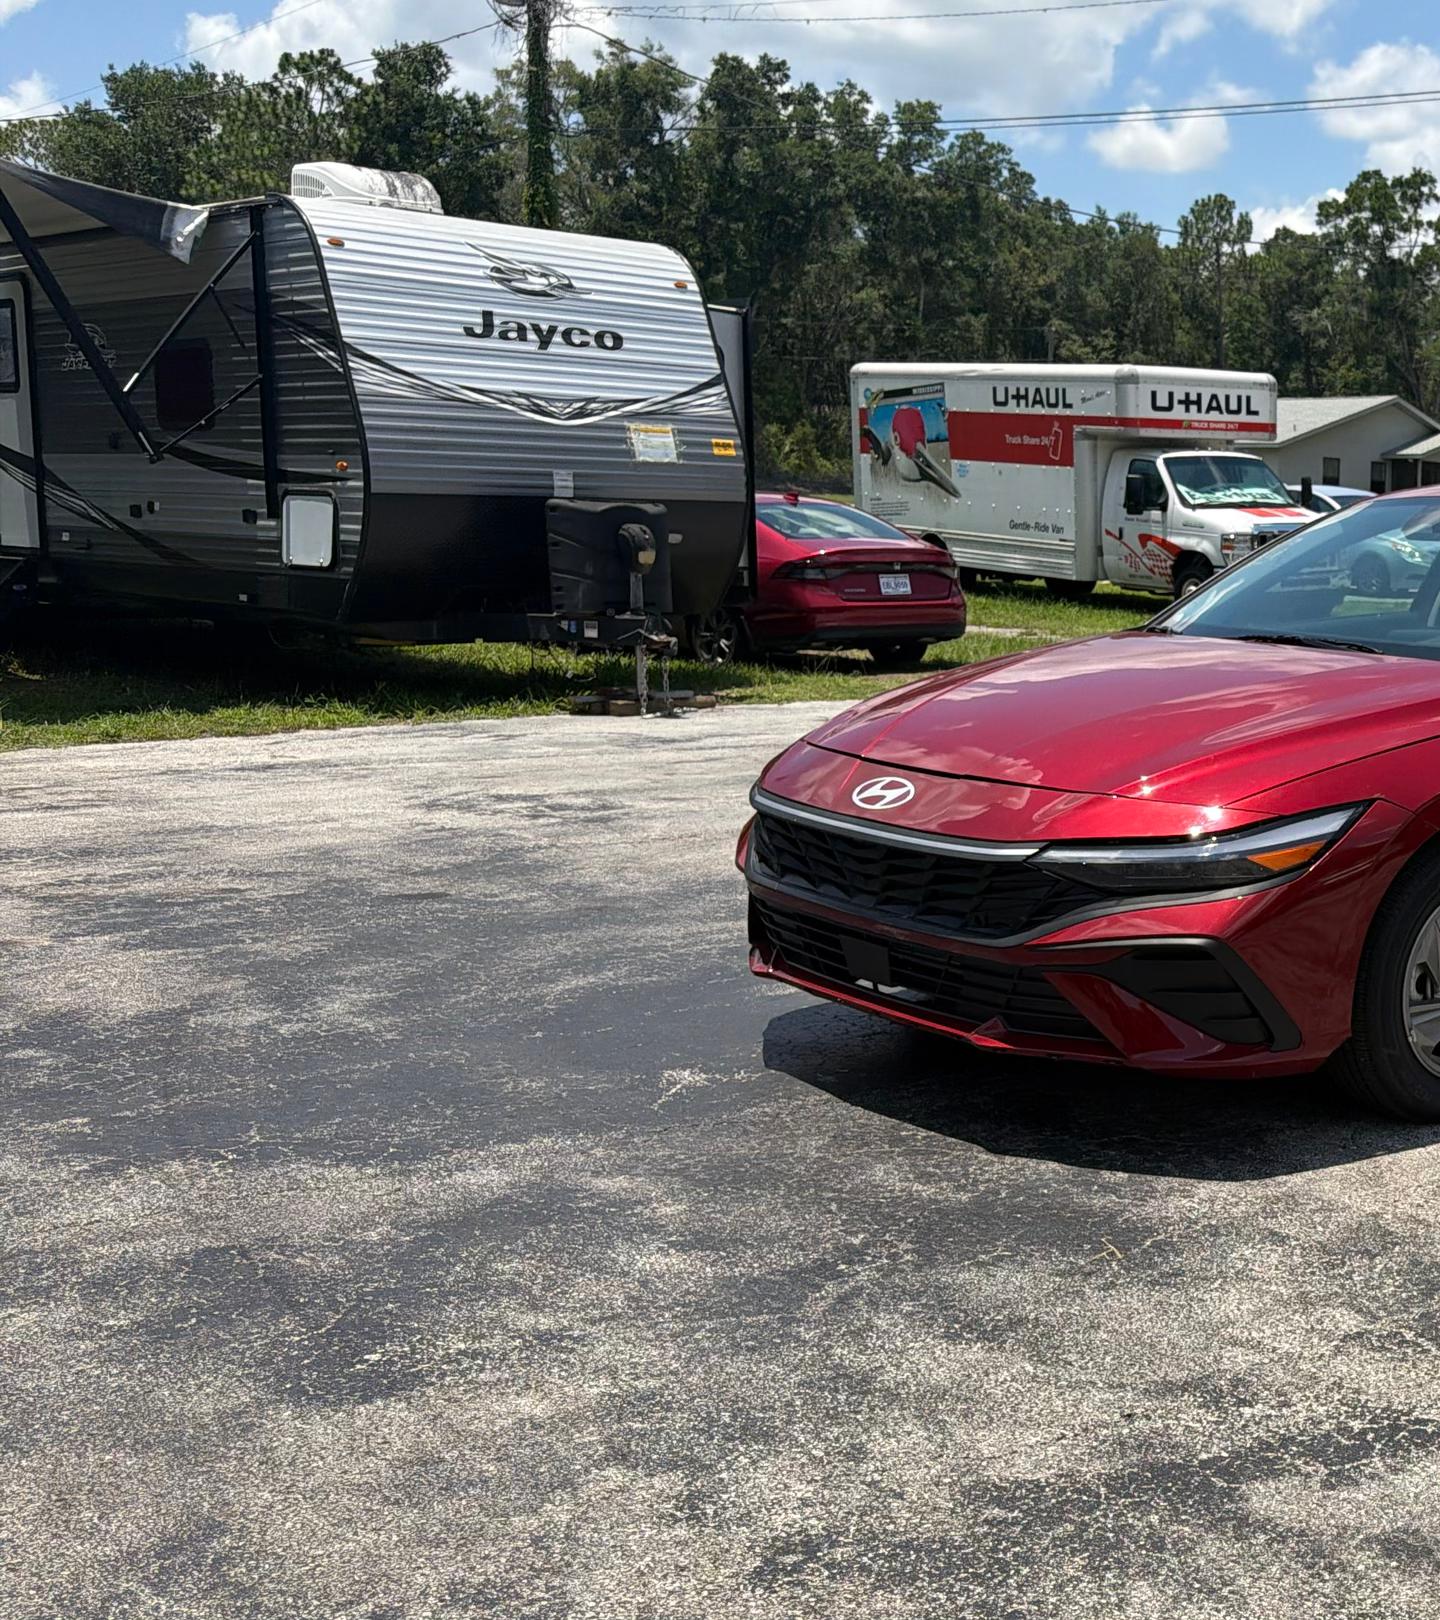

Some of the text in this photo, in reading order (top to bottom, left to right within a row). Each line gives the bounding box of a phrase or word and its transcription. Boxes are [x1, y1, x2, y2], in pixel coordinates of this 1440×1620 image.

[463, 310, 624, 351] Jayco
[1005, 434, 1021, 444] Truck
[1023, 435, 1040, 445] Share
[1009, 519, 1064, 534] Gentle-Ride Van
